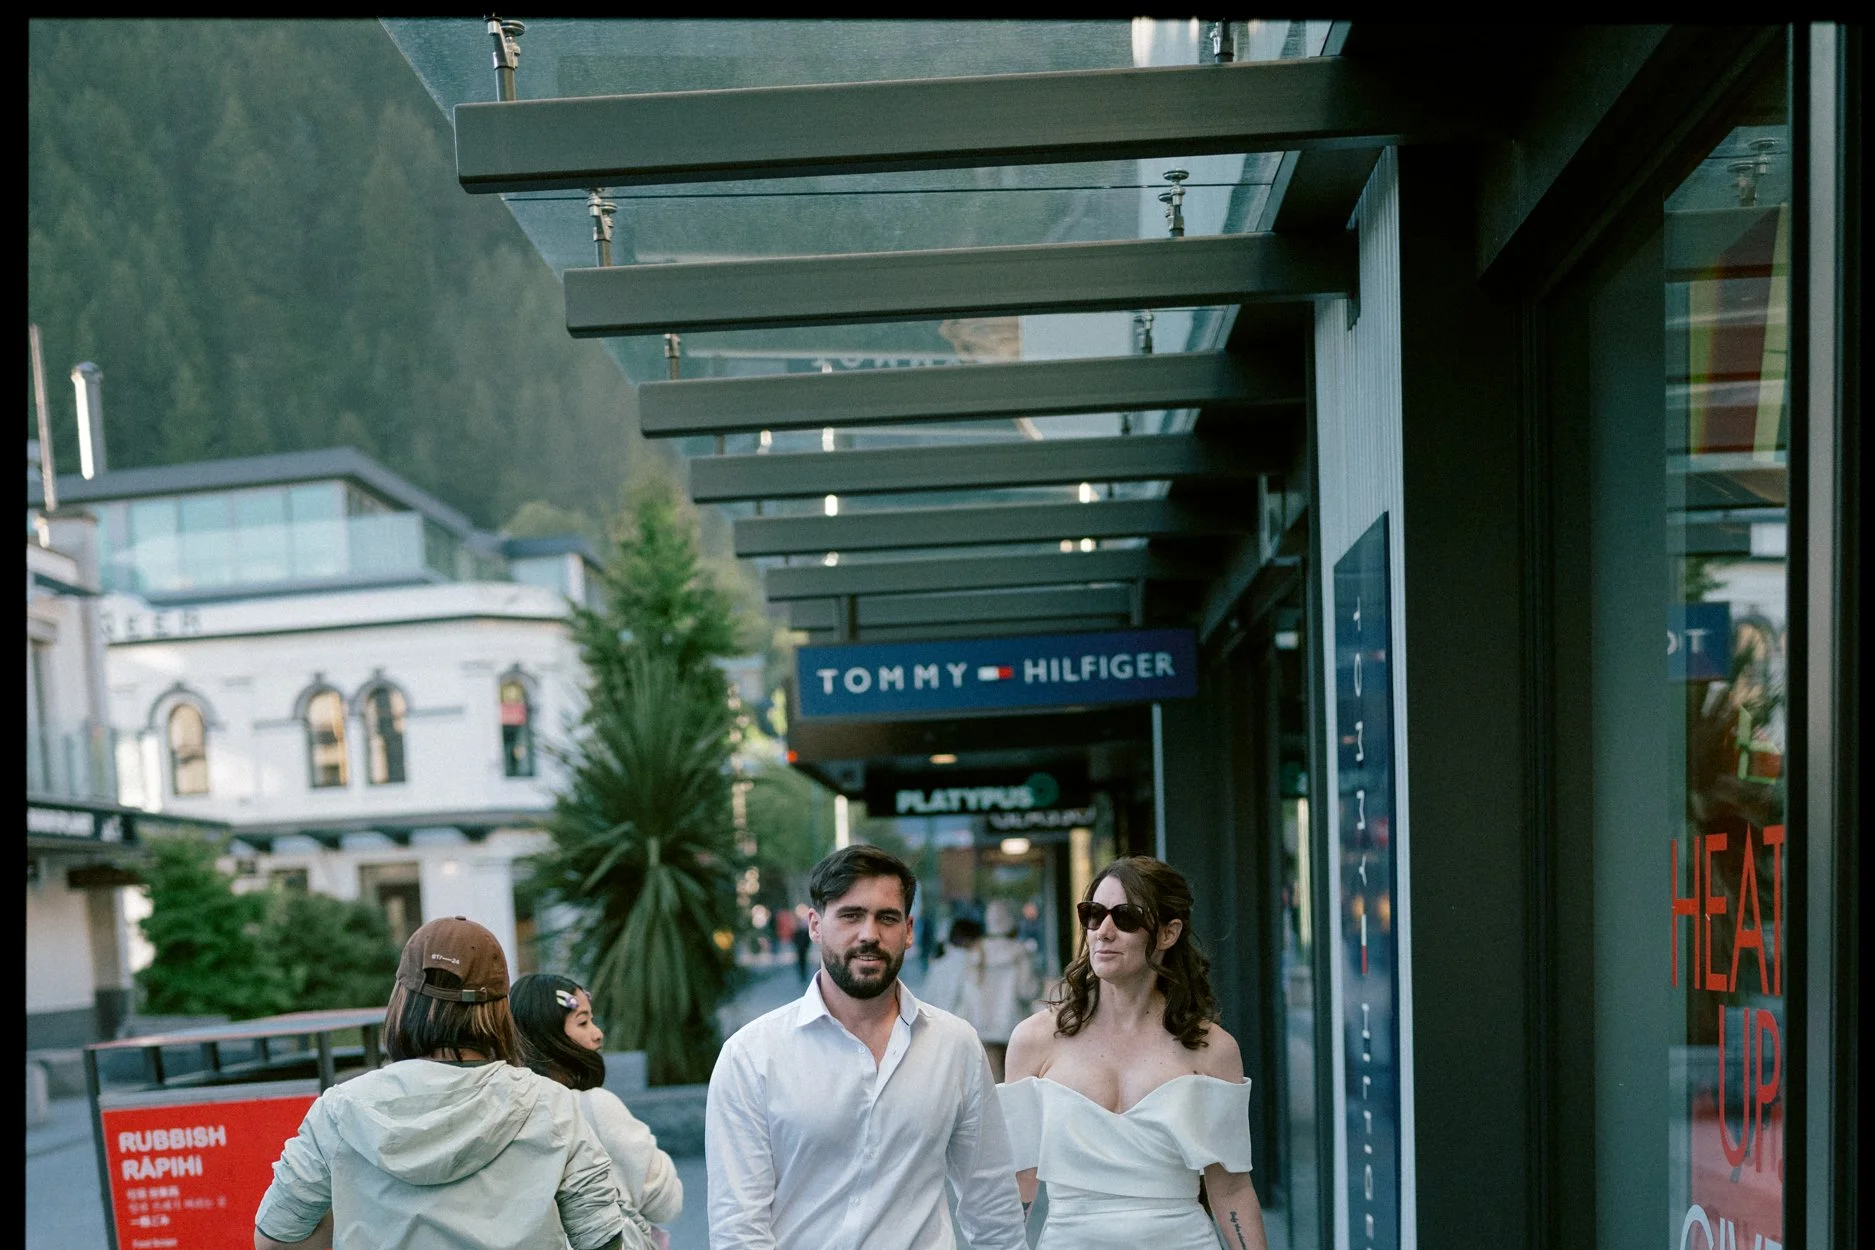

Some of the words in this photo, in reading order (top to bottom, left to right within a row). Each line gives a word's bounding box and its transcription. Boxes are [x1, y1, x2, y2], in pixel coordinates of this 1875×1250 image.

[816, 662, 968, 695] TOMMY
[1023, 652, 1175, 684] HILFIGER
[896, 786, 1035, 813] PLATYPUS
[1671, 822, 1786, 996] HEAT
[118, 1125, 227, 1153] RUBBISH
